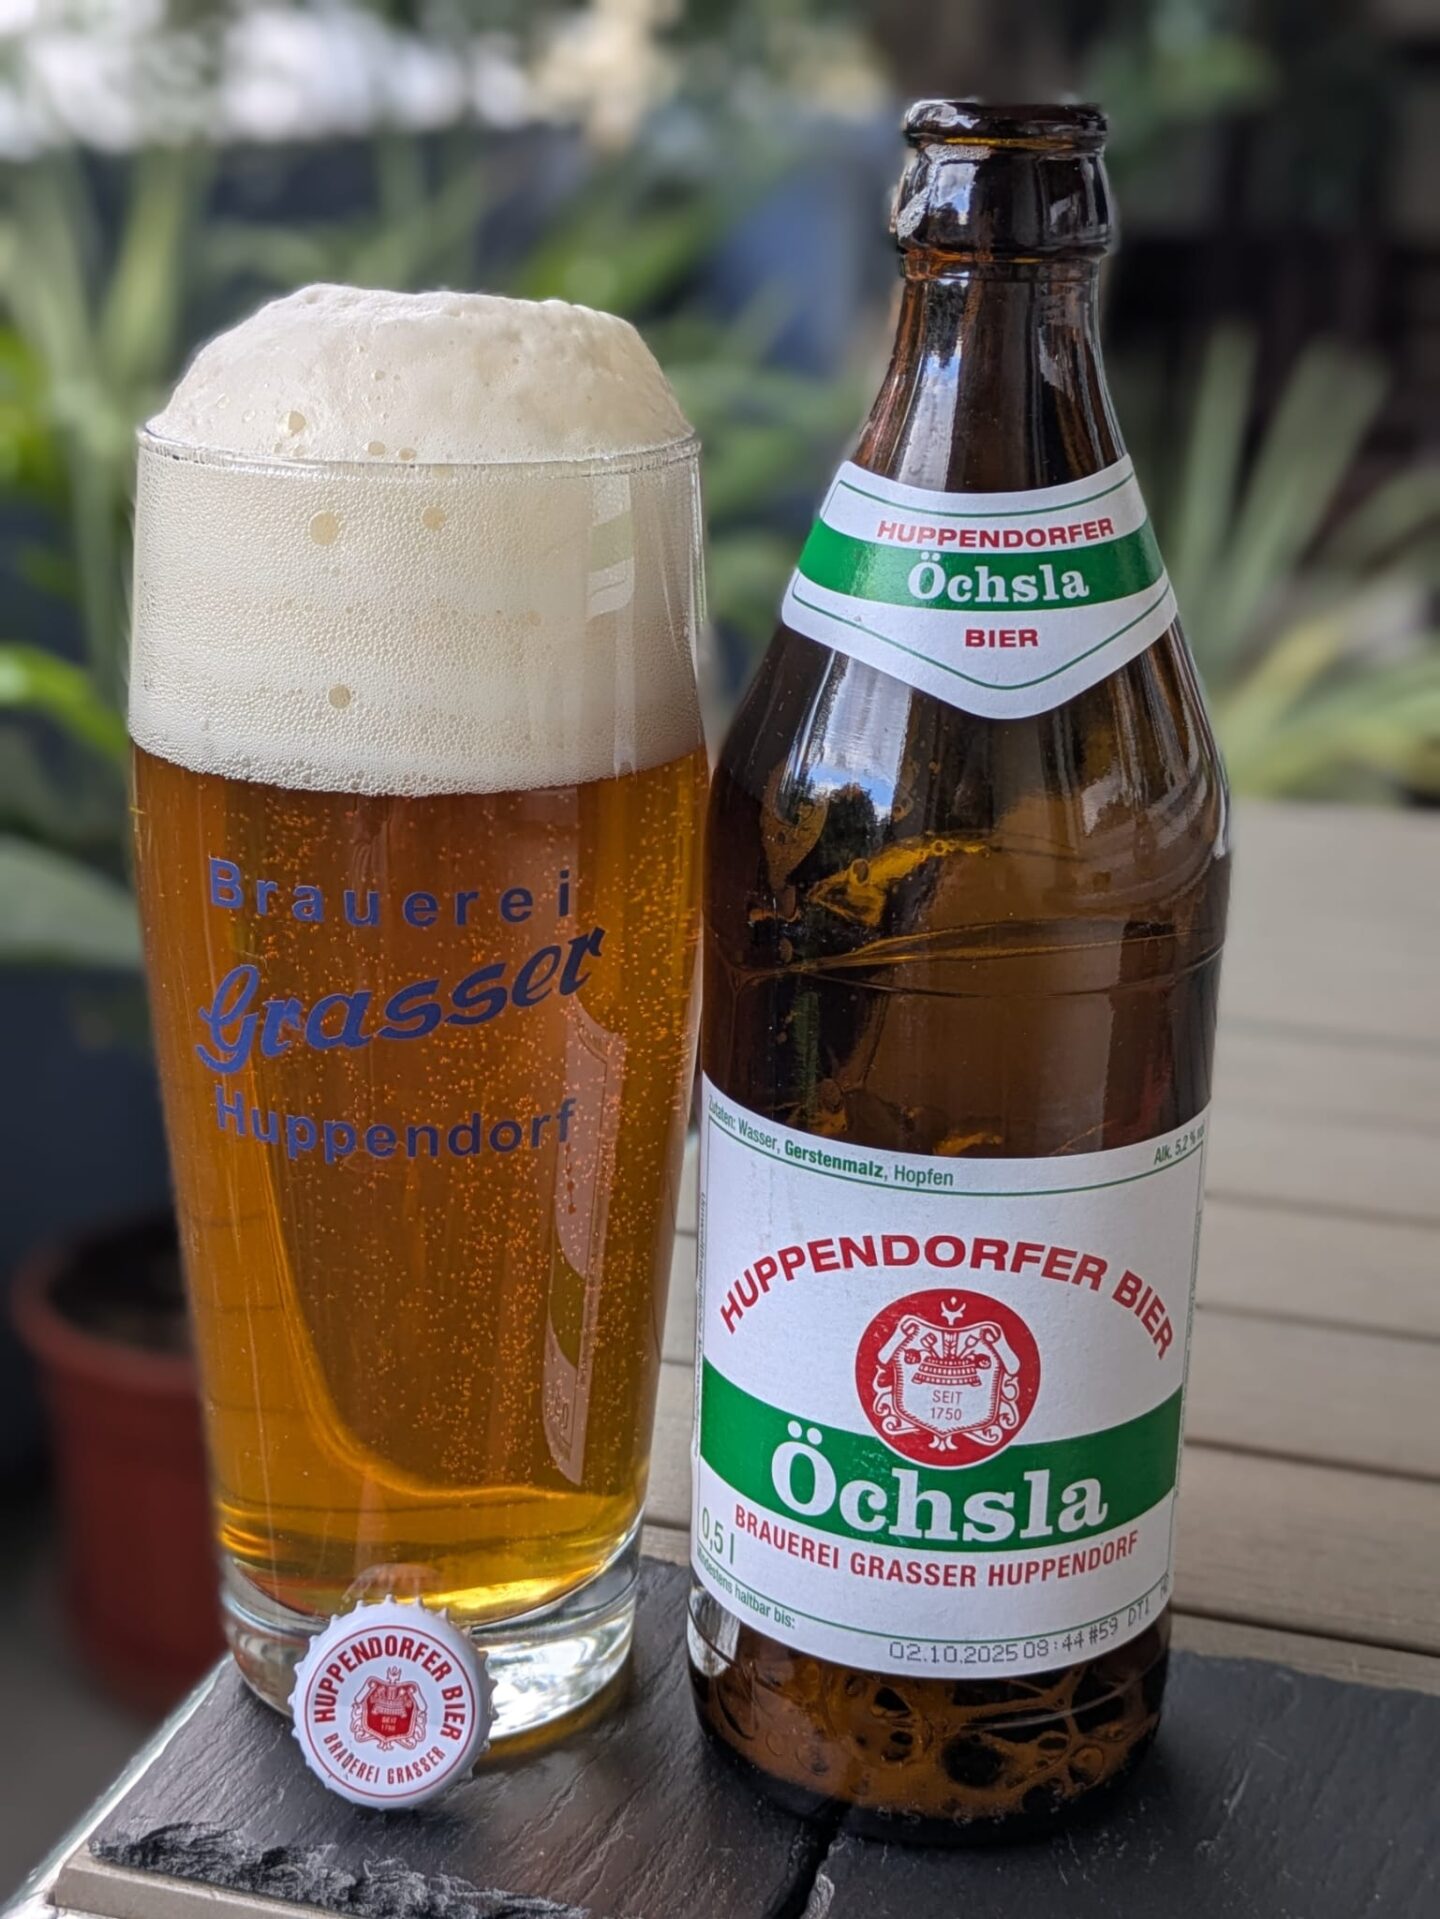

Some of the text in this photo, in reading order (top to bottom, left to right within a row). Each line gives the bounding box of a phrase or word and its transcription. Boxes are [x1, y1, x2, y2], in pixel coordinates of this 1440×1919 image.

[877, 517, 1115, 548] HUPPENDORFER
[906, 551, 1090, 603] Öchsla
[964, 628, 1039, 648] BIER
[209, 857, 571, 927] Brauerei
[195, 926, 605, 1074] Grasser
[214, 1084, 576, 1164] Huppendorf
[738, 1117, 780, 1154] Wasser,
[784, 1138, 888, 1181] Gerstenmalz,
[894, 1164, 954, 1187] Hopfen
[1153, 1144, 1172, 1166] Alk.
[719, 1233, 1109, 1335] HUPPENDORFER
[1111, 1269, 1174, 1361] BIER
[930, 1407, 962, 1421] 1750
[932, 1390, 962, 1405] SEIT
[771, 1420, 1108, 1543] Öchsla
[701, 1507, 724, 1555] 0,5
[734, 1503, 1139, 1588] BRAUEREI GRASSER HUPPENDORF
[734, 1583, 772, 1618] haltbar
[774, 1605, 796, 1630] bis:
[890, 1641, 1018, 1664] 02.10.2025
[1089, 1615, 1118, 1646] #59
[314, 1635, 466, 1742] HUPPENDORFER BIER
[323, 1731, 446, 1785] BRAUEREI GRASSER
